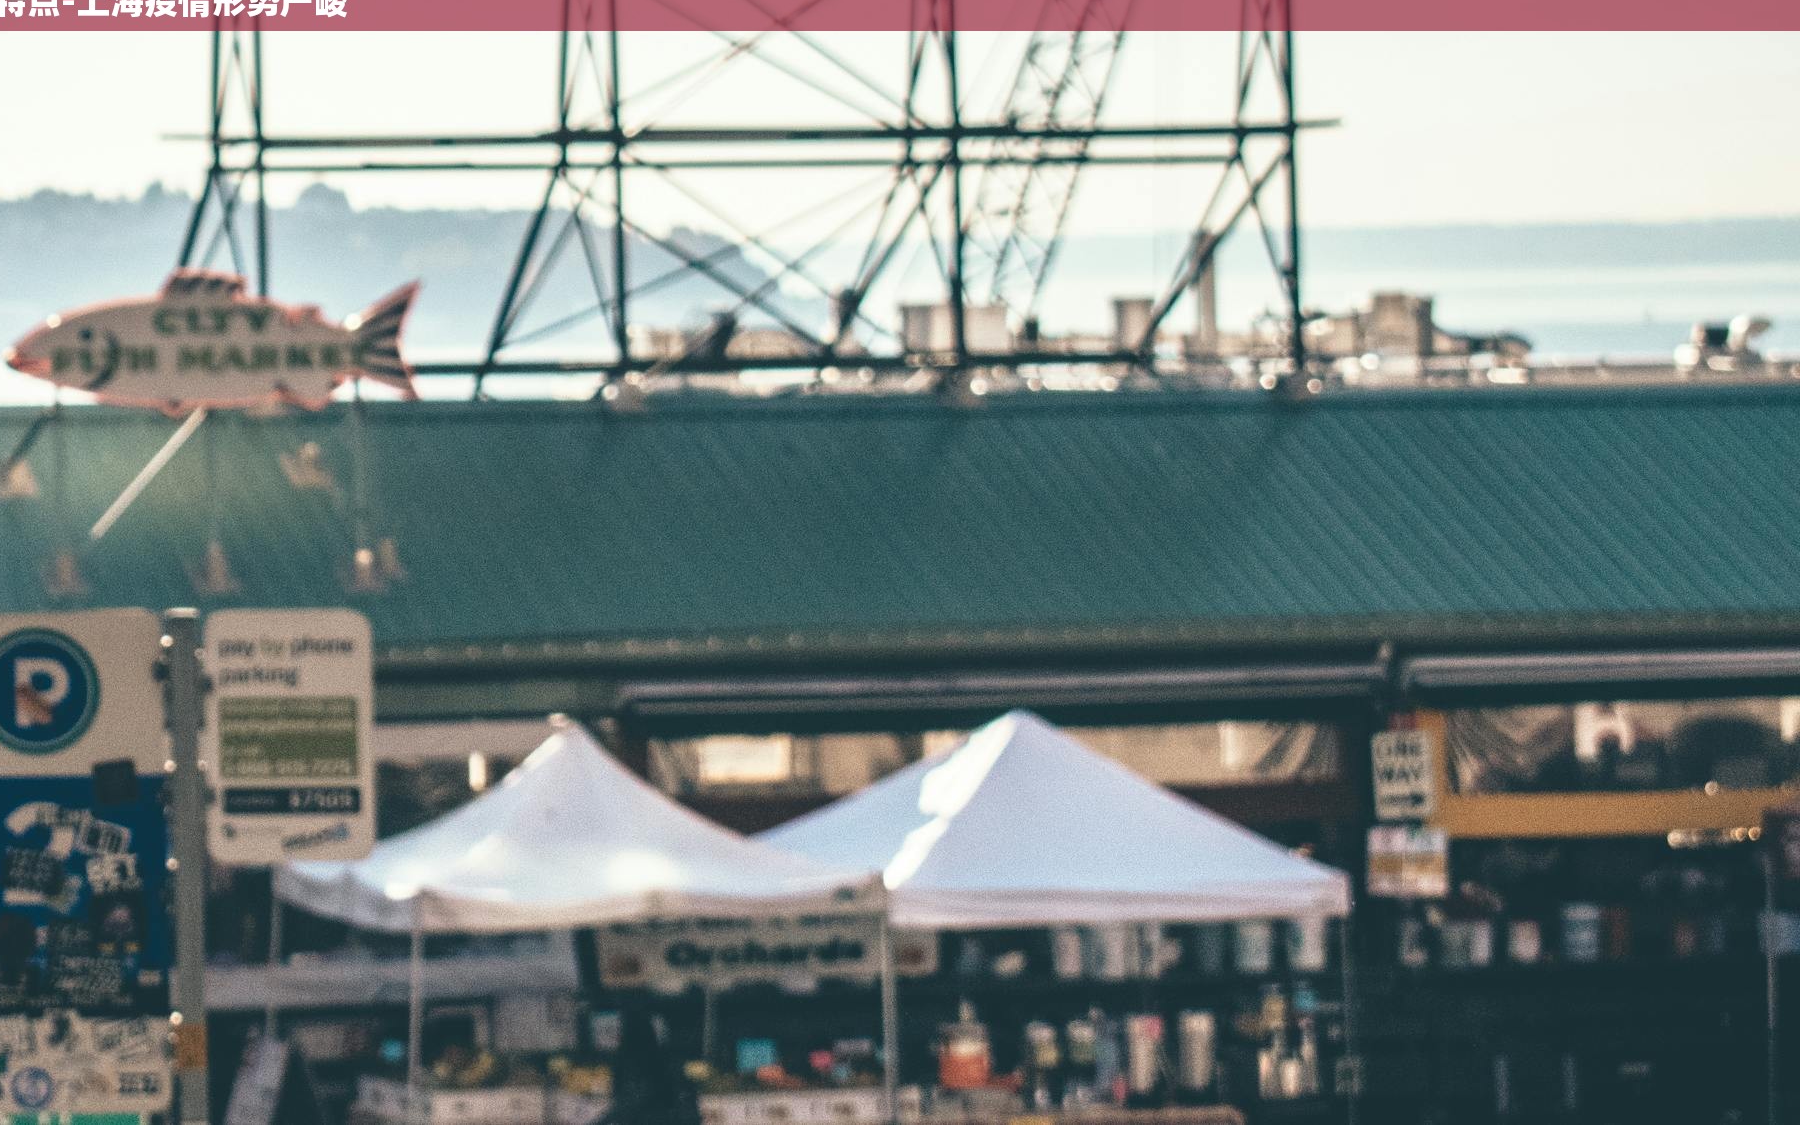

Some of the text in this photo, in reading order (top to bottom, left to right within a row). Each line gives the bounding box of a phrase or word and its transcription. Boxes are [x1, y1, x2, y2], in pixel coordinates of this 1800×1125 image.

[152, 307, 271, 335] CITY
[218, 639, 253, 657] pay
[290, 636, 354, 656] phone
[218, 667, 298, 687] parking
[13, 656, 70, 729] P
